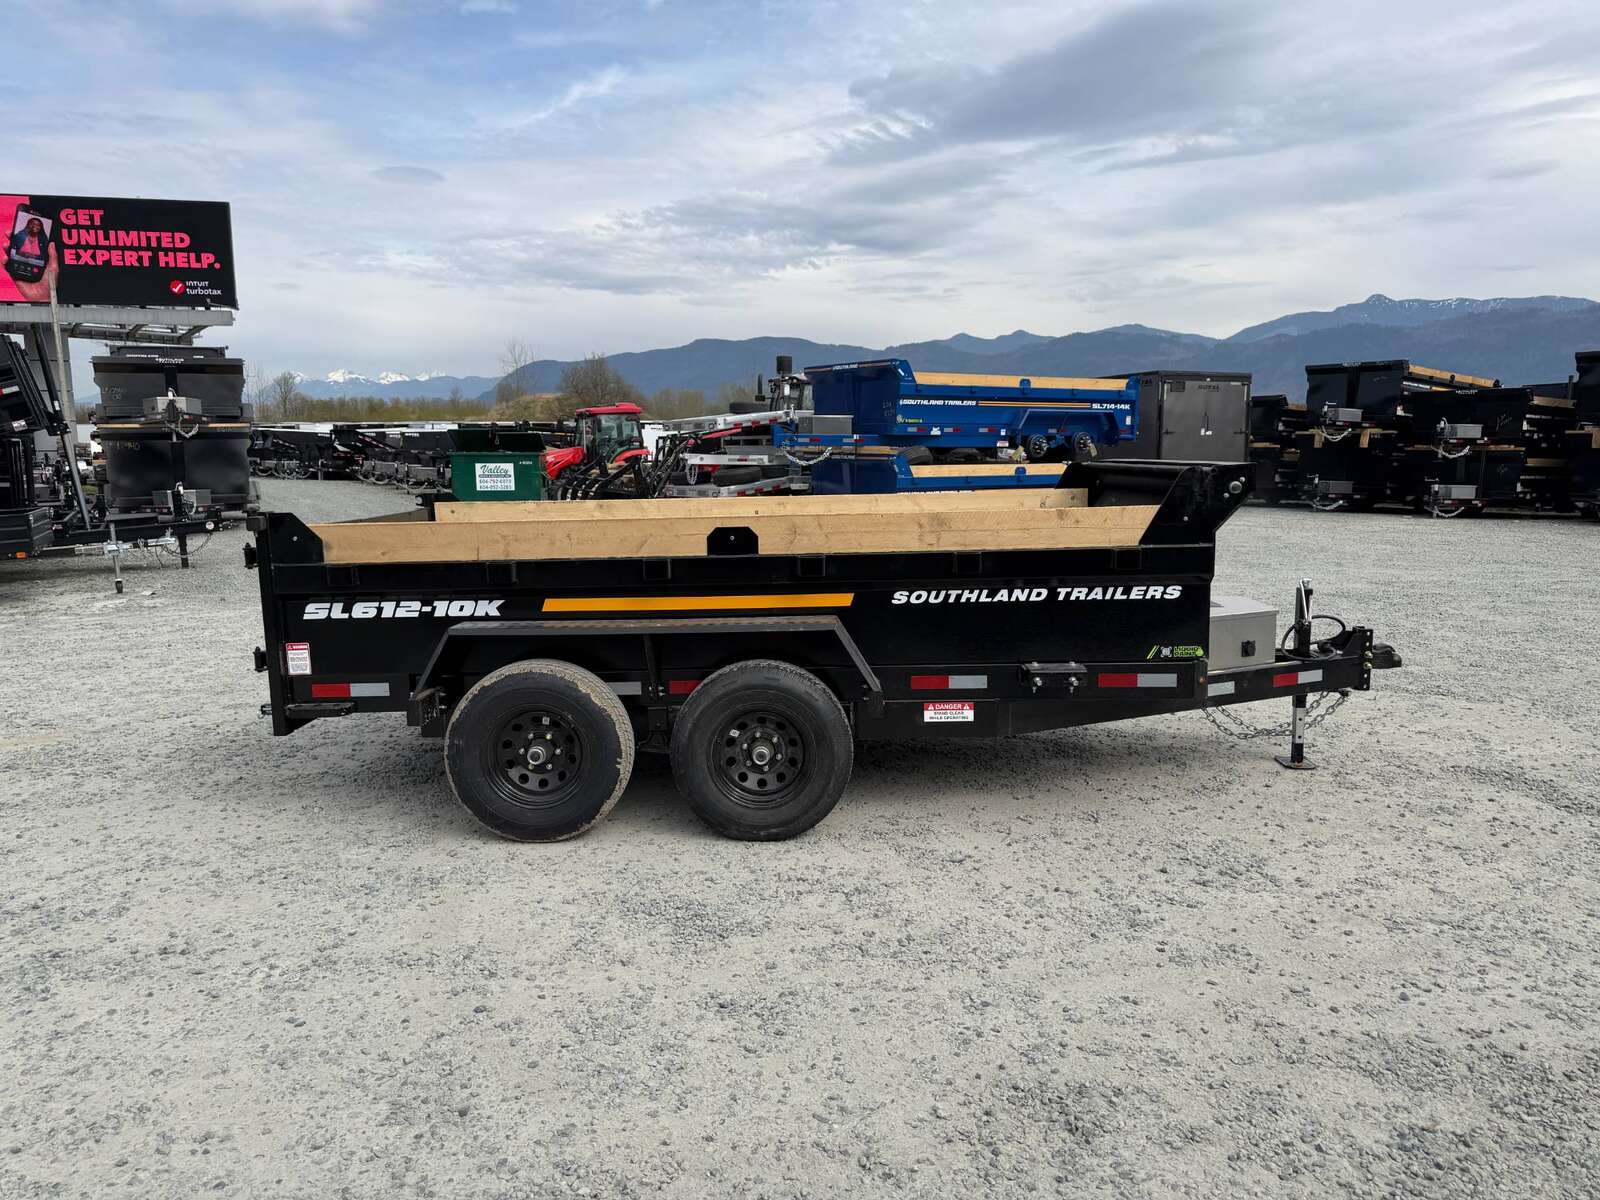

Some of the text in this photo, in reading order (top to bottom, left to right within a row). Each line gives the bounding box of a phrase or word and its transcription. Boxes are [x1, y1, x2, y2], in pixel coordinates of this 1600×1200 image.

[60, 208, 104, 225] GET
[61, 228, 191, 249] UNLIMITED
[63, 249, 221, 270] EXPERT HELP.
[186, 287, 222, 295] turbotax
[480, 465, 509, 474] Valley
[891, 585, 1183, 605] SOUTHLAND TRAILERS
[303, 599, 506, 620] SL612-10K
